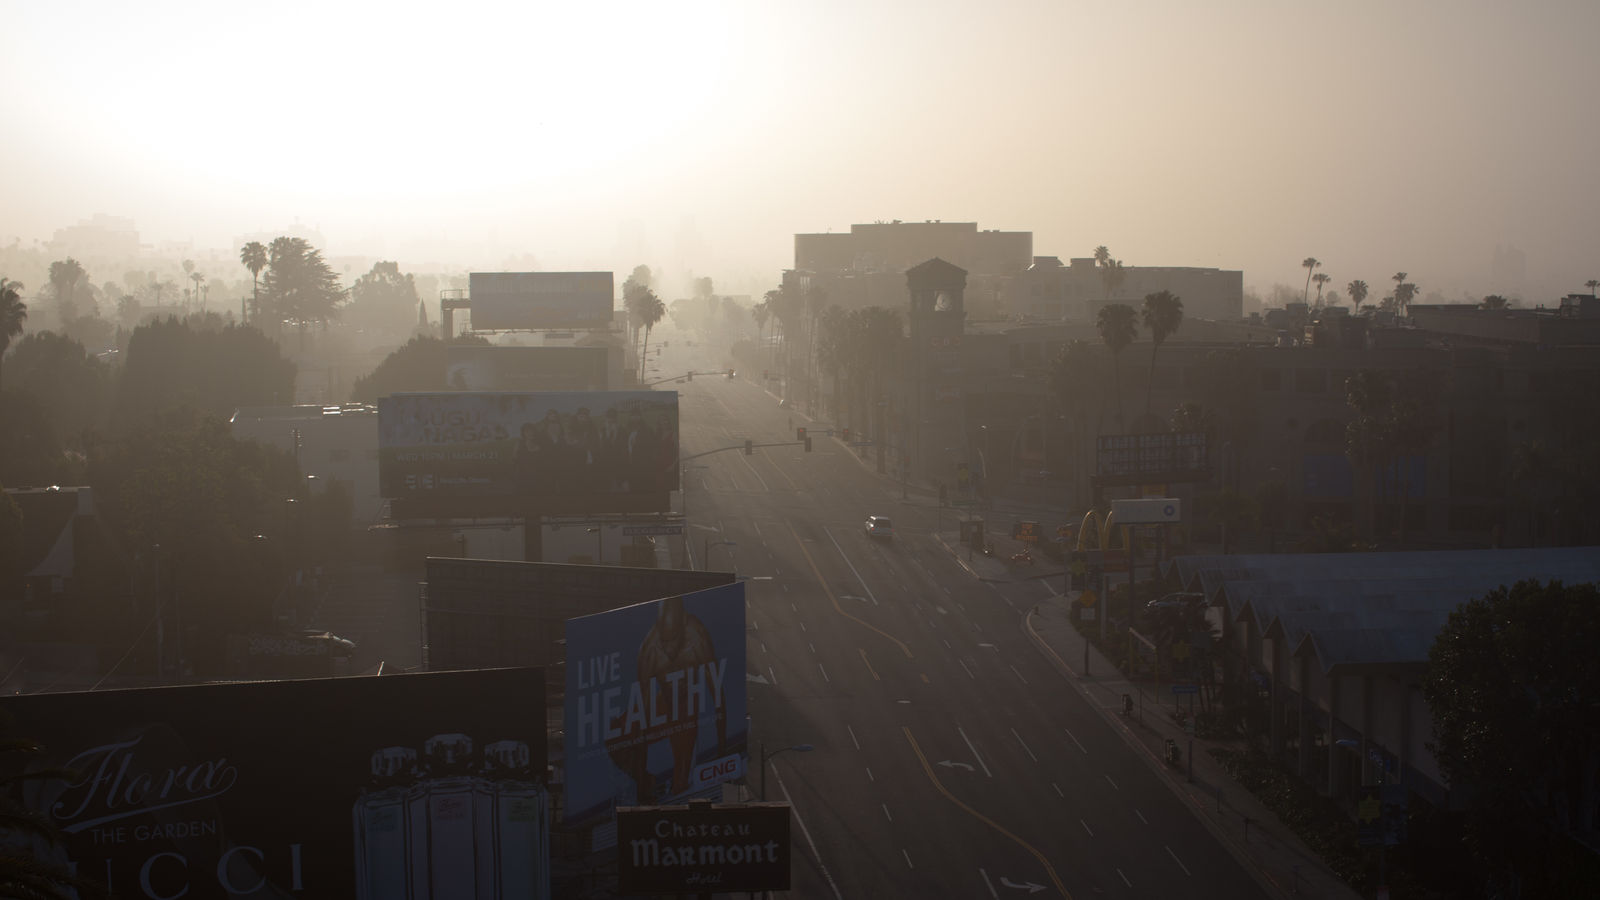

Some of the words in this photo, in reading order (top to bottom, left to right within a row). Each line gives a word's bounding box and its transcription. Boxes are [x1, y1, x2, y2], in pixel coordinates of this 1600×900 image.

[577, 652, 621, 690] LIVE
[577, 657, 728, 748] HEALTHY
[52, 734, 239, 833] Flora
[699, 759, 737, 782] CNG
[91, 827, 129, 845] THE
[134, 818, 217, 841] GARDEN
[654, 819, 751, 838] Chateau
[630, 838, 780, 868] Marmont
[66, 843, 305, 900] UCCI
[685, 871, 722, 886] Hotel
